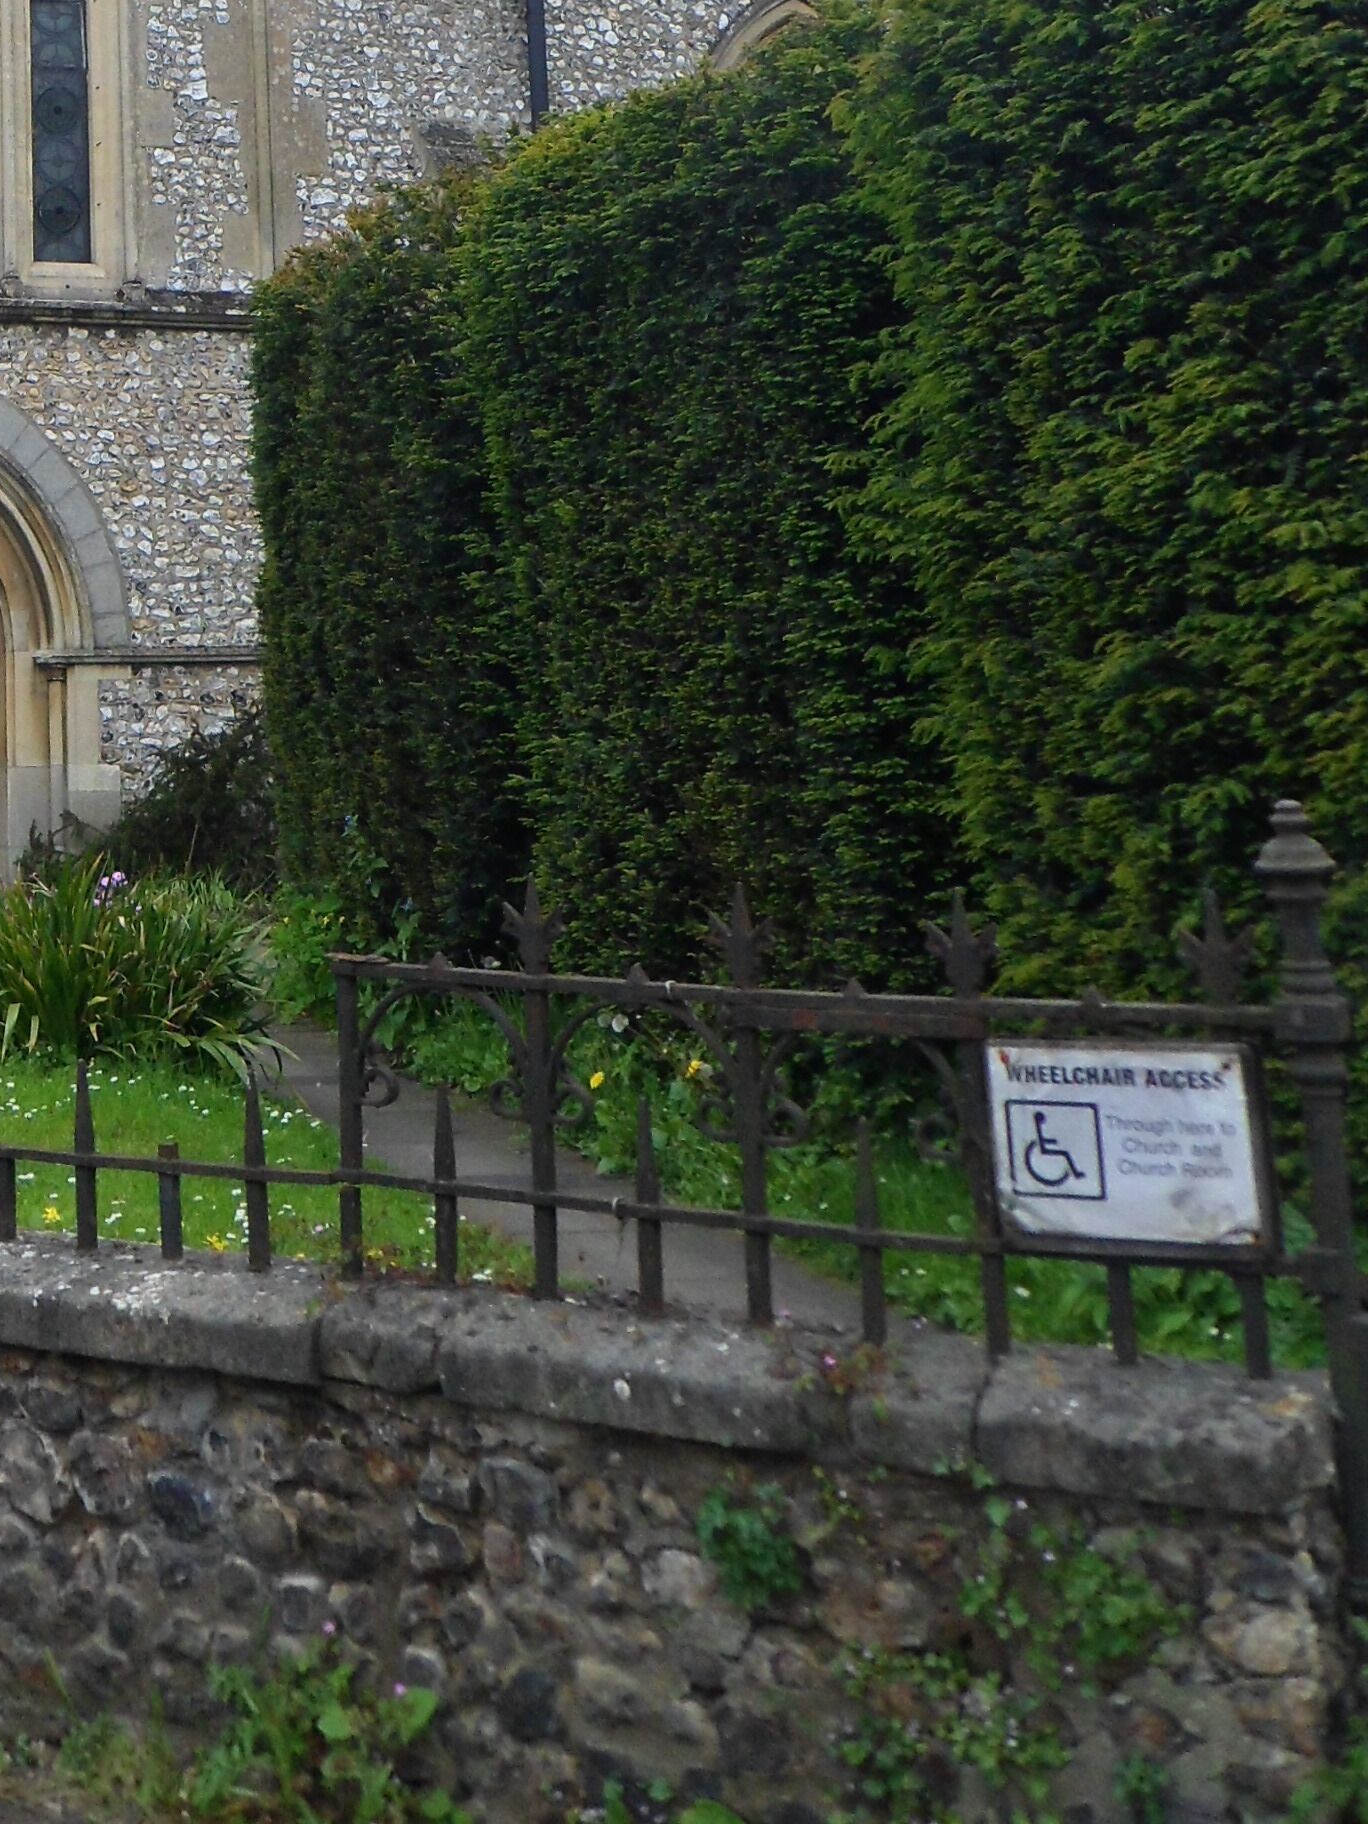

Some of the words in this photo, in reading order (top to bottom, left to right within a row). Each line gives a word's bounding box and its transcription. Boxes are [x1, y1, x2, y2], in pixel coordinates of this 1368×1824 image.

[1007, 1062, 1135, 1087] WHEELCHAIR
[1145, 1068, 1226, 1090] ACCESS
[1105, 1114, 1175, 1137] Through
[1178, 1119, 1215, 1135] here
[1219, 1121, 1236, 1136] to
[1122, 1137, 1182, 1154] Church
[1190, 1140, 1222, 1157] and
[1117, 1159, 1176, 1175] Church
[1182, 1162, 1233, 1178] Room
